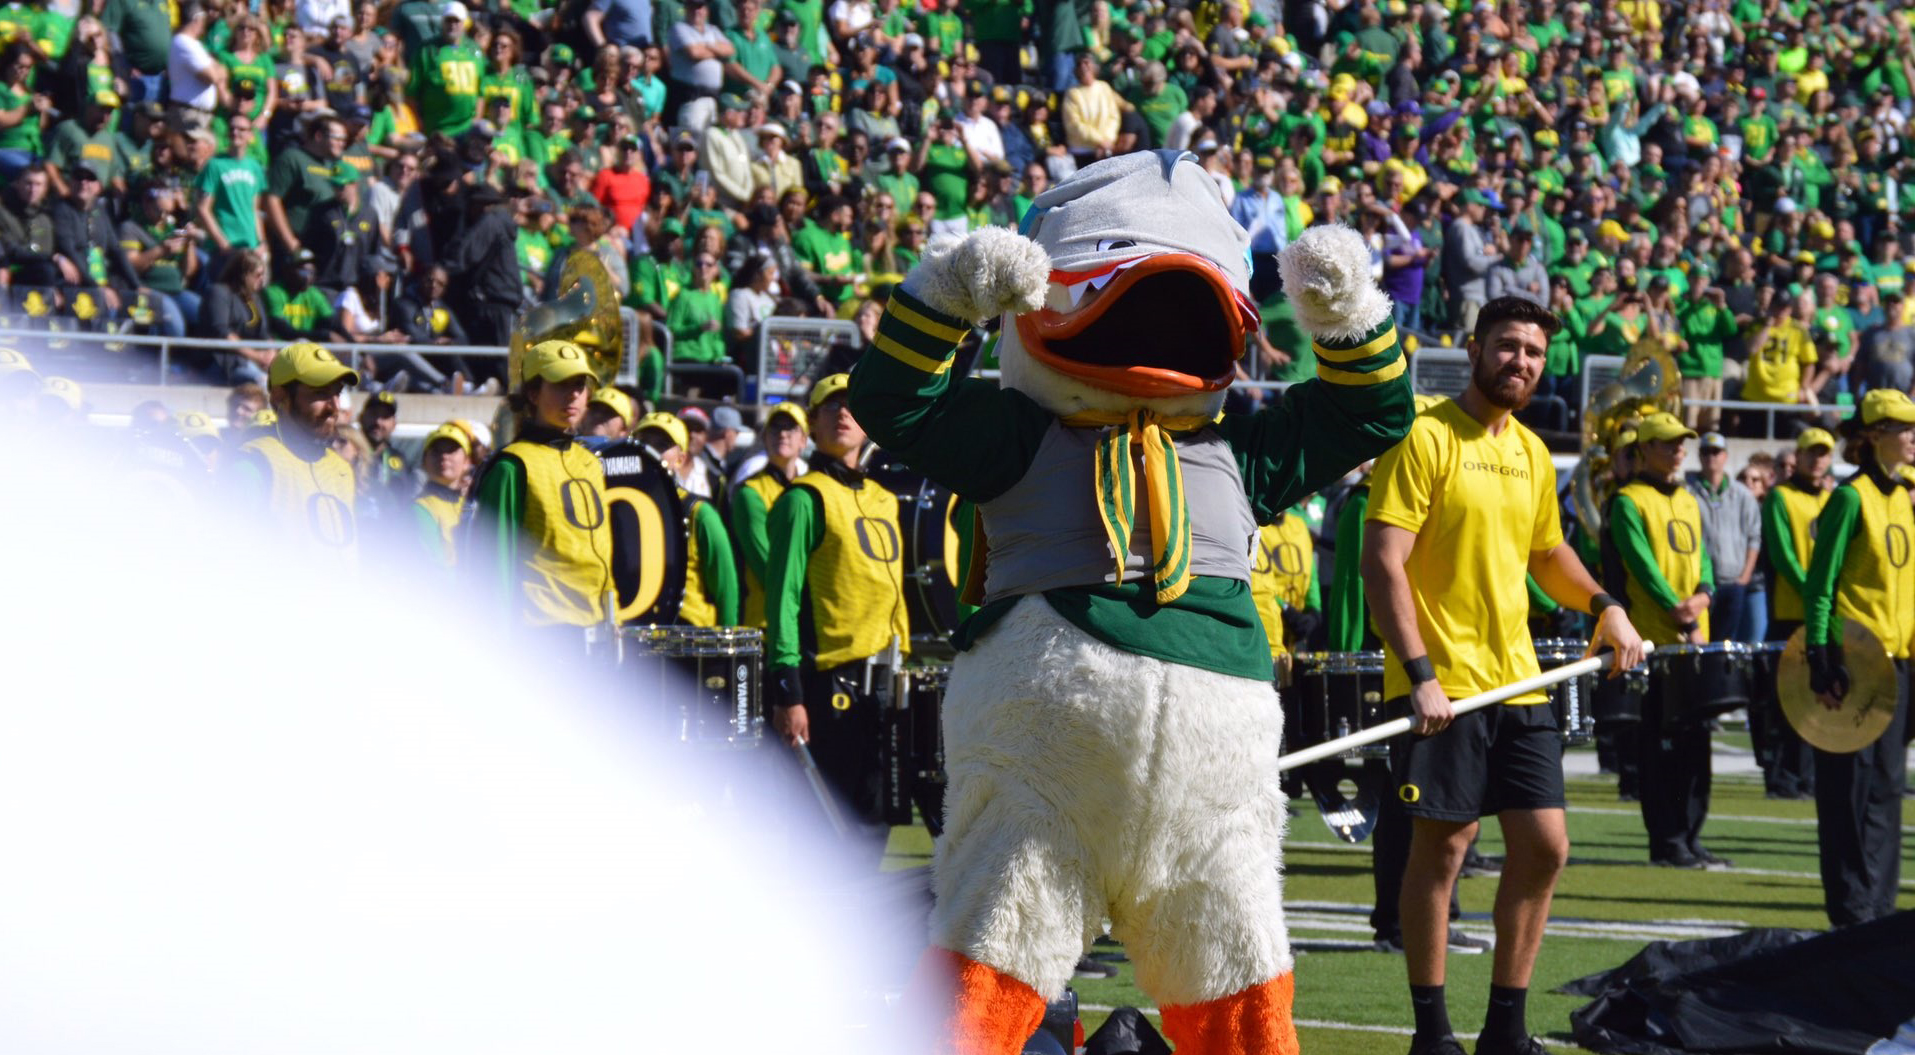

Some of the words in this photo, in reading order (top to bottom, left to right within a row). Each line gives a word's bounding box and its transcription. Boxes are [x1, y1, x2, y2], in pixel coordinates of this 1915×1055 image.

[606, 455, 643, 476] YAMAHA
[855, 516, 899, 562] O
[1667, 519, 1697, 555] O
[737, 681, 748, 734] YAMAHA
[1569, 685, 1580, 732] YAMAHA
